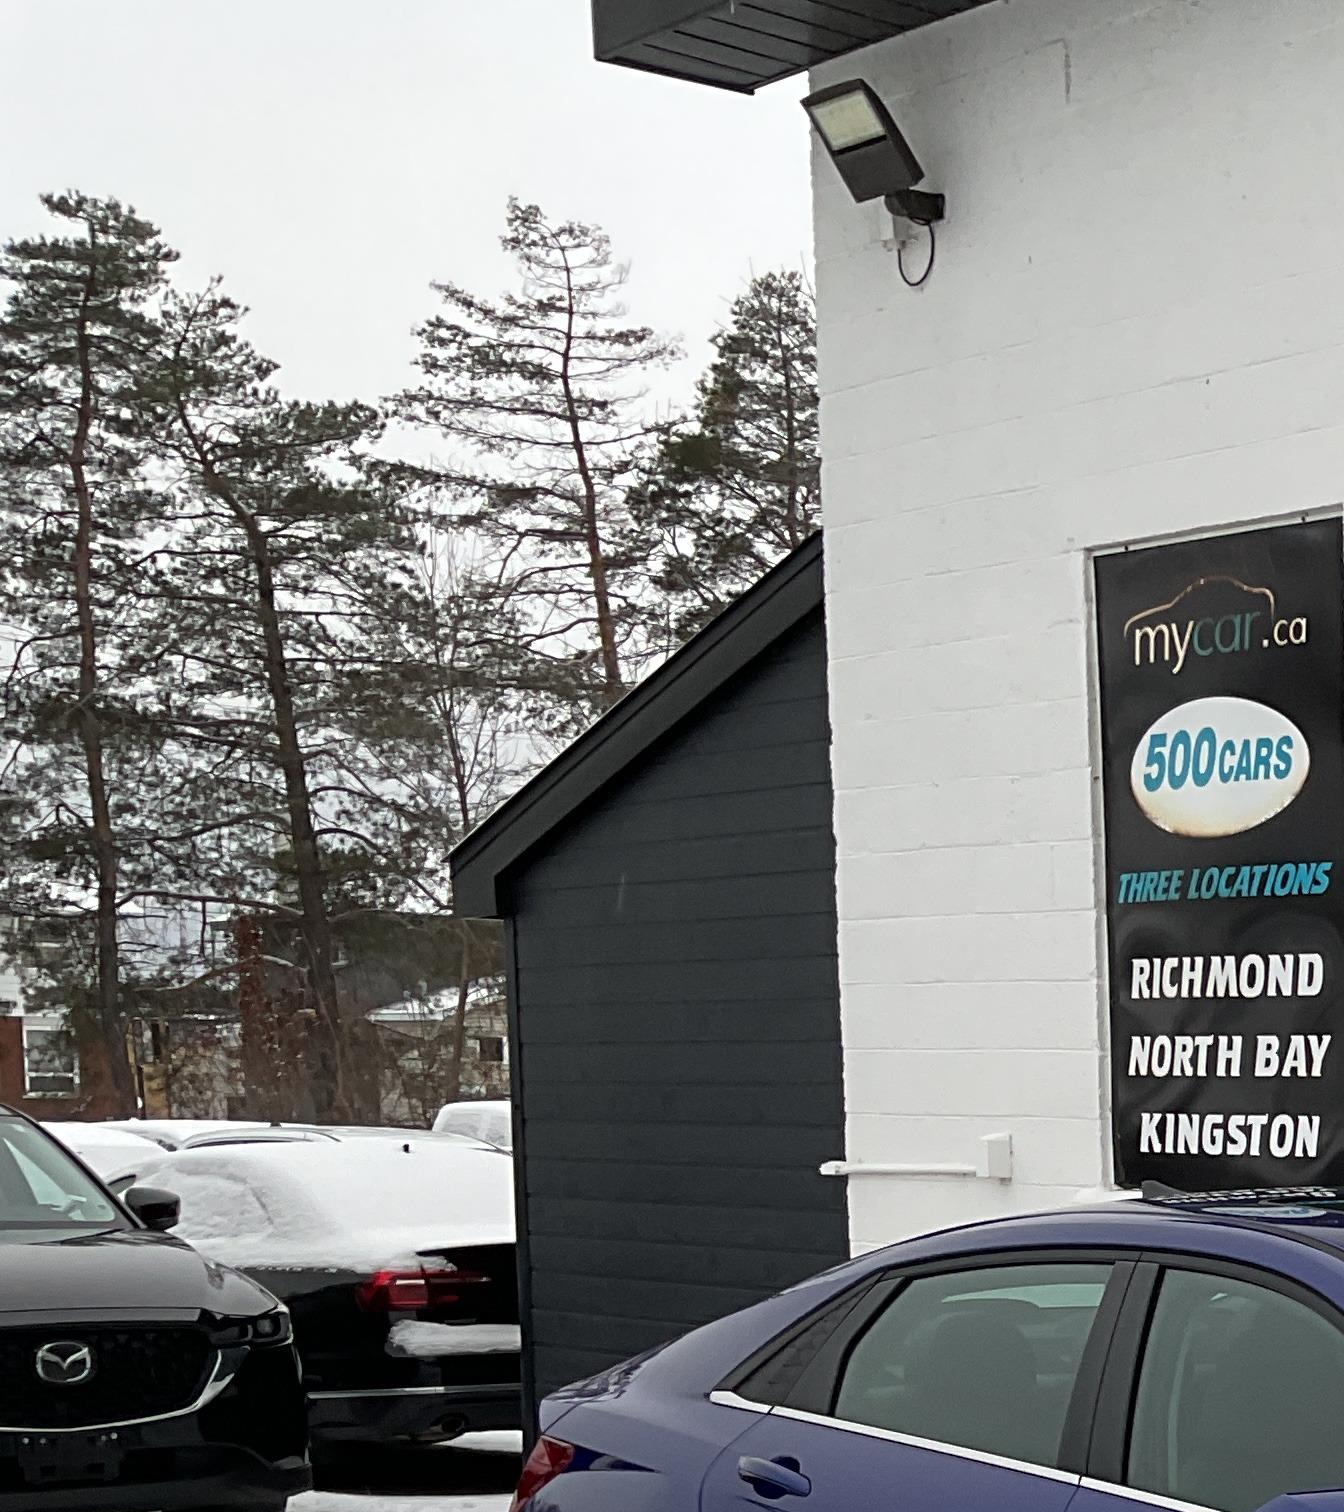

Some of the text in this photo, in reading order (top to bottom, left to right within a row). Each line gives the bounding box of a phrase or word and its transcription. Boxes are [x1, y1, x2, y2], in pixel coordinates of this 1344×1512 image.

[1133, 611, 1307, 675] mycar.ca
[1118, 861, 1333, 904] THREE LOCATIONS
[1130, 952, 1324, 1000] RICHMOND
[1127, 1033, 1332, 1078] NORTH BAY
[1139, 1112, 1321, 1158] KINGSTON
